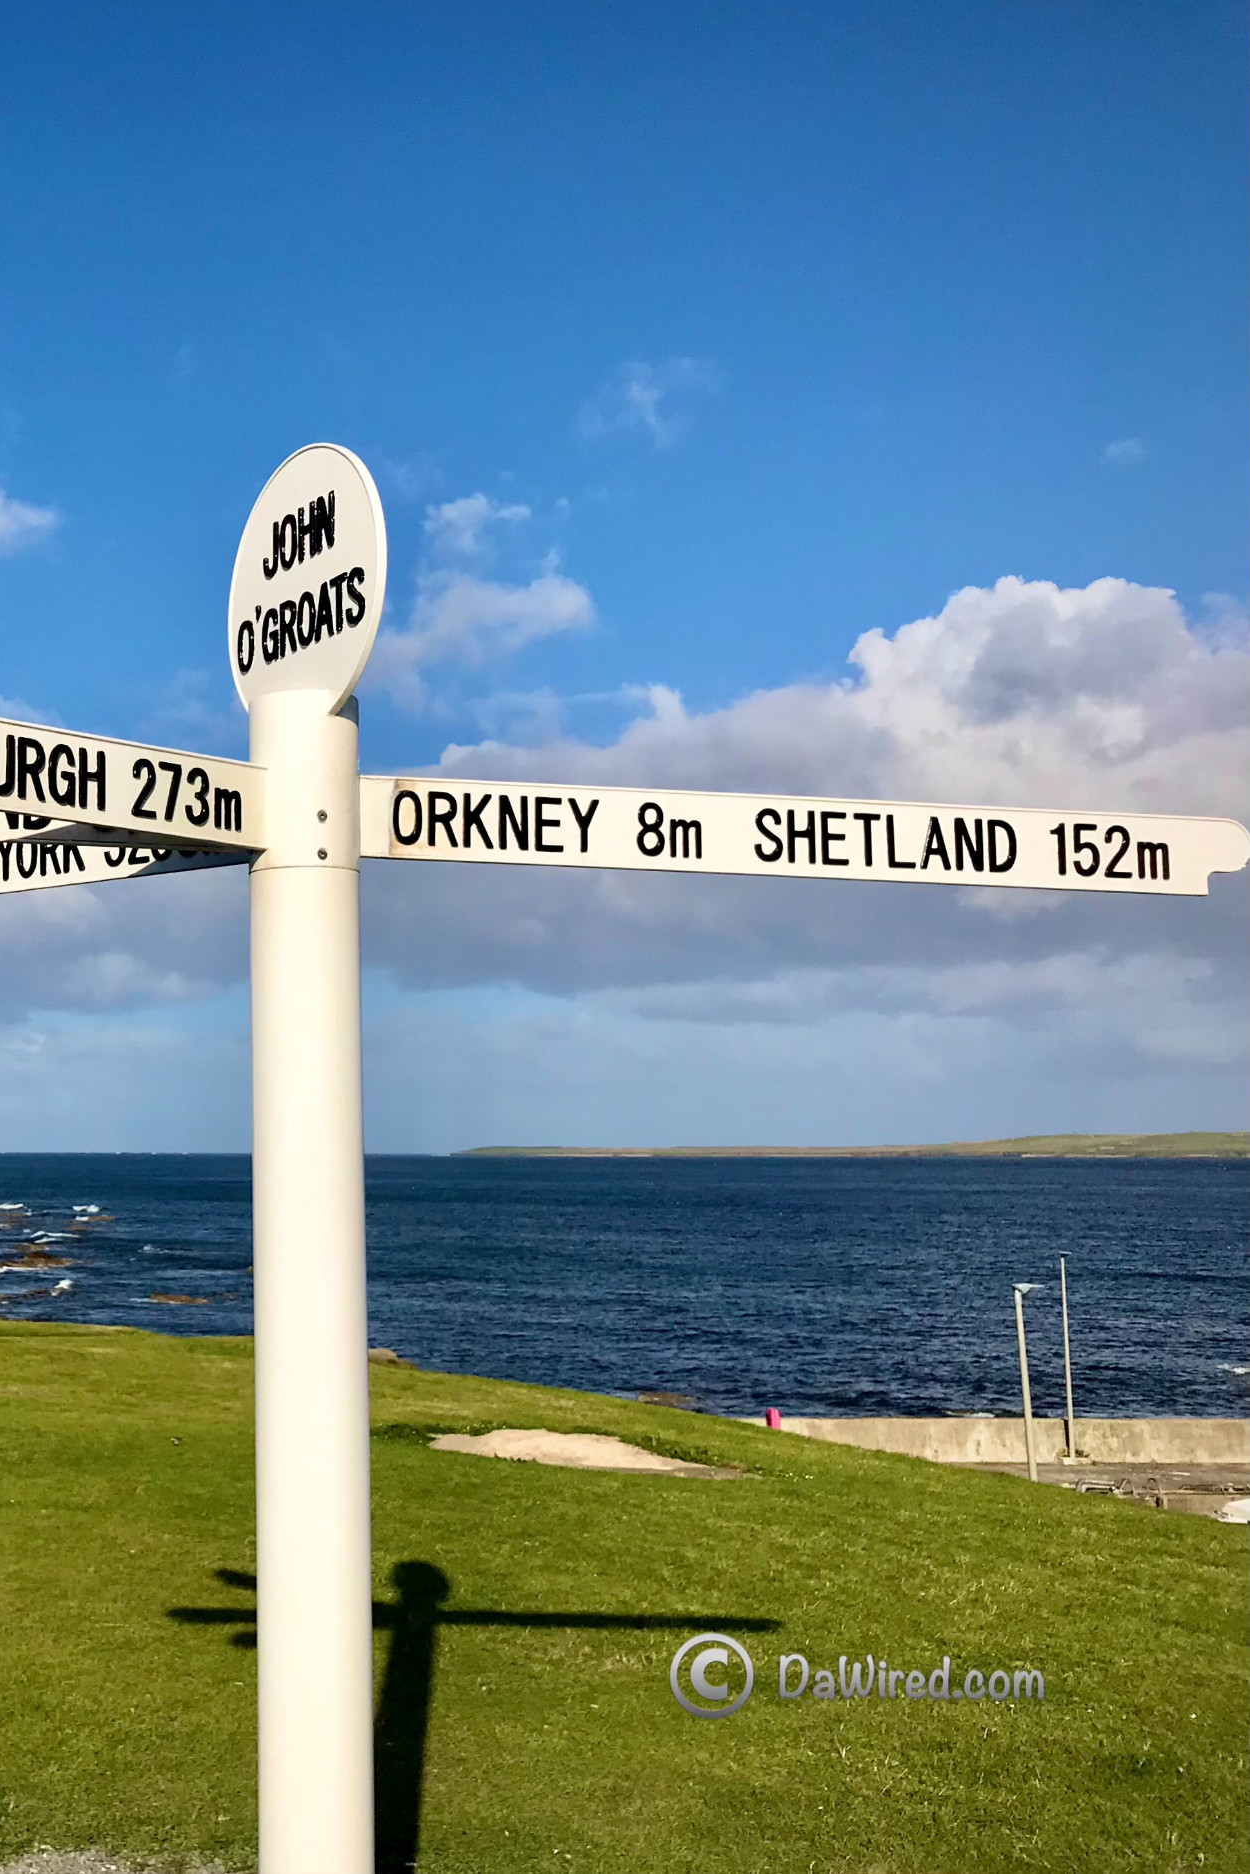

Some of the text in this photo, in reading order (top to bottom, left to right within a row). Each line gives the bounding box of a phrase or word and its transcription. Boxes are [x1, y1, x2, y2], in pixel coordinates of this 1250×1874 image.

[263, 490, 335, 580] JOHN
[237, 566, 366, 675] O'GROATS
[131, 758, 242, 832] 273m
[391, 790, 1170, 880] ORKNEY 8m SHETLAND 152m
